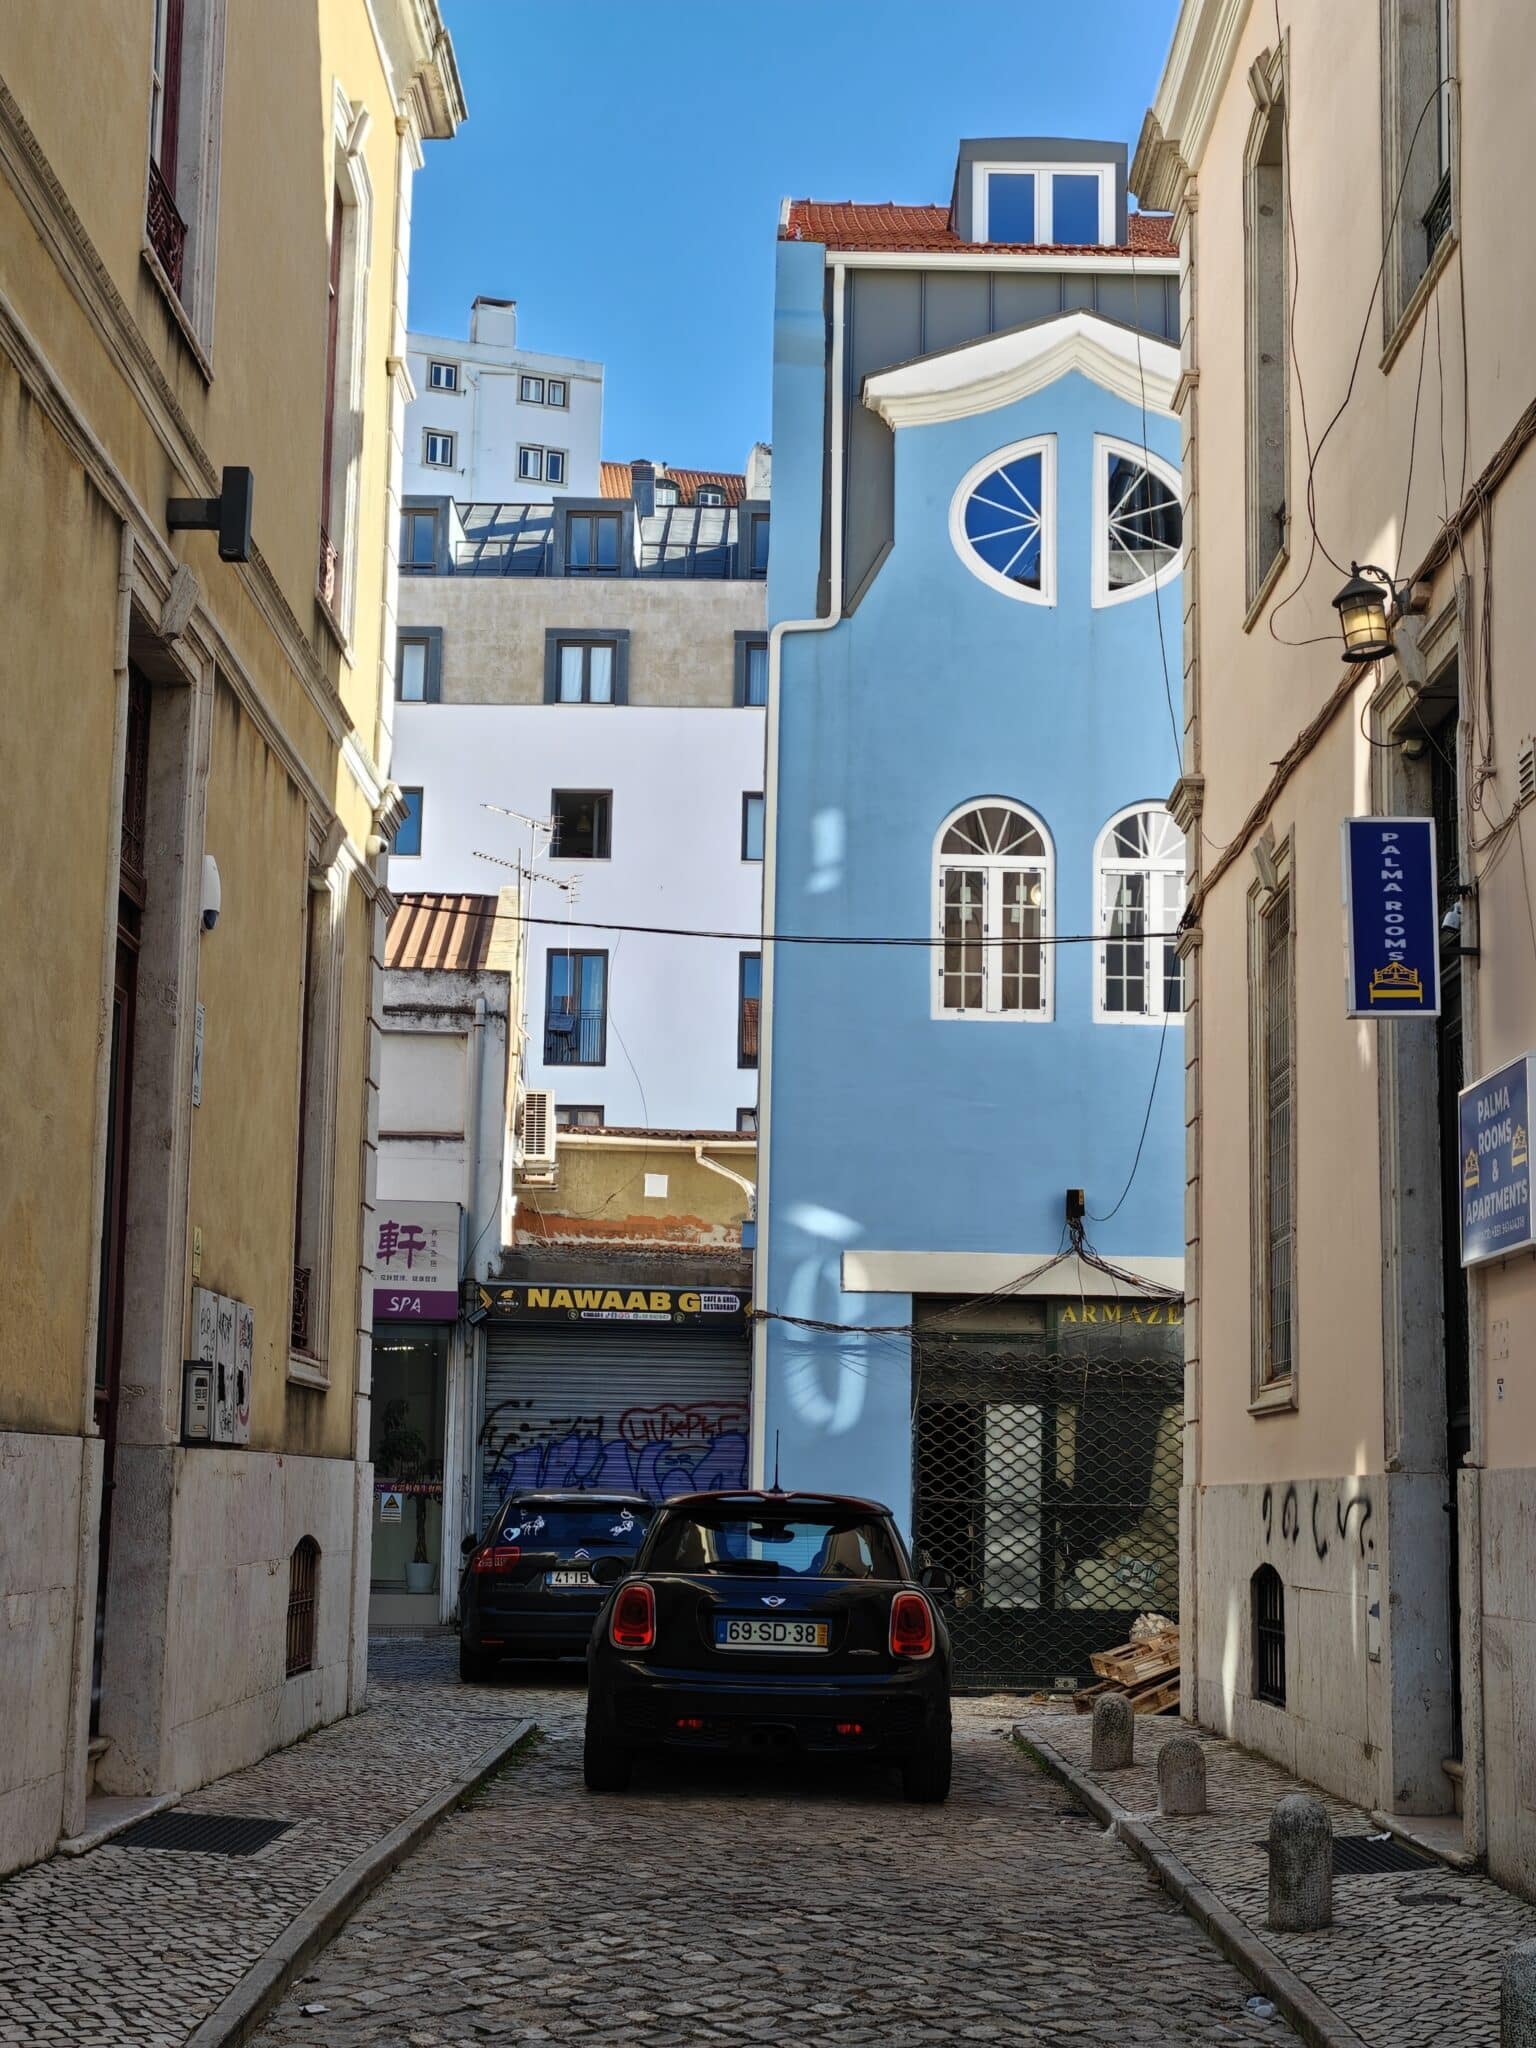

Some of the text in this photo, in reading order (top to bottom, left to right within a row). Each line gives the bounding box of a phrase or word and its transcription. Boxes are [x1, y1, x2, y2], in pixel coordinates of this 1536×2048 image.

[1381, 832, 1406, 961] PALMA ROOMS
[1477, 1086, 1510, 1124] PALMA
[1478, 1117, 1512, 1155] ROOMS
[1492, 1158, 1499, 1183] &
[1466, 1178, 1528, 1226] APARTMENTS
[376, 1220, 426, 1269] 軒
[386, 1297, 421, 1313] SPA
[527, 1288, 701, 1312] NAWAAB G
